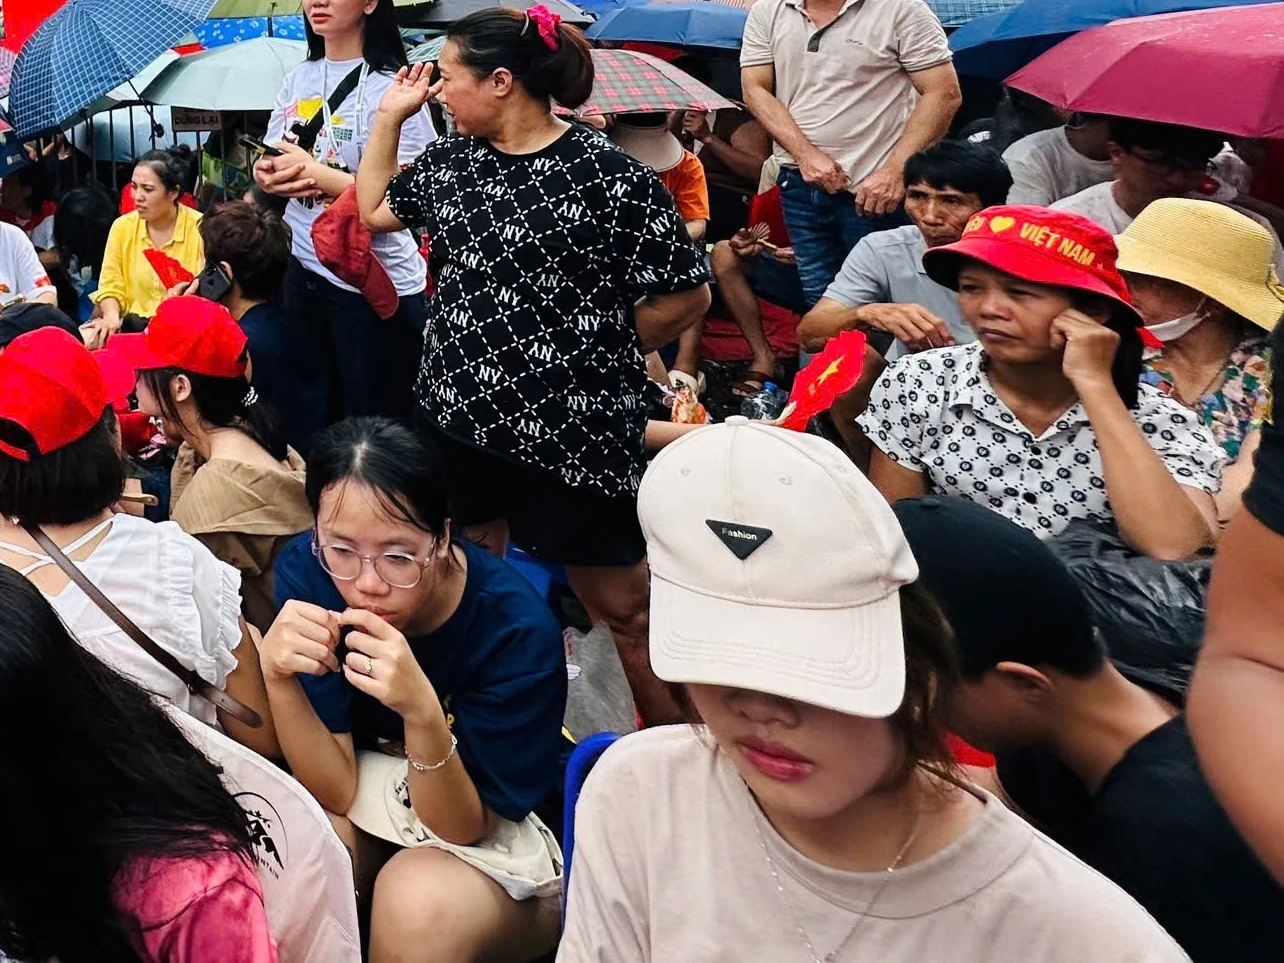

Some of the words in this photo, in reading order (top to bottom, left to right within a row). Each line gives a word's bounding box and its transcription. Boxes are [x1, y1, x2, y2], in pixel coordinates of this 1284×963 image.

[532, 157, 556, 171] NY
[439, 204, 459, 220] NY
[557, 201, 584, 220] NY
[502, 223, 526, 242] NY
[650, 213, 673, 235] NY
[1019, 223, 1061, 248] VIỆT
[1057, 237, 1096, 266] NAM
[460, 250, 480, 269] NY
[536, 273, 559, 287] NY
[498, 286, 522, 306] NY
[449, 308, 469, 327] NY
[577, 315, 600, 331] NY
[528, 342, 553, 362] NY
[478, 364, 502, 384] NY
[438, 384, 455, 404] NY
[567, 395, 588, 411] NY
[516, 418, 541, 437] NY
[721, 527, 758, 541] Fashion
